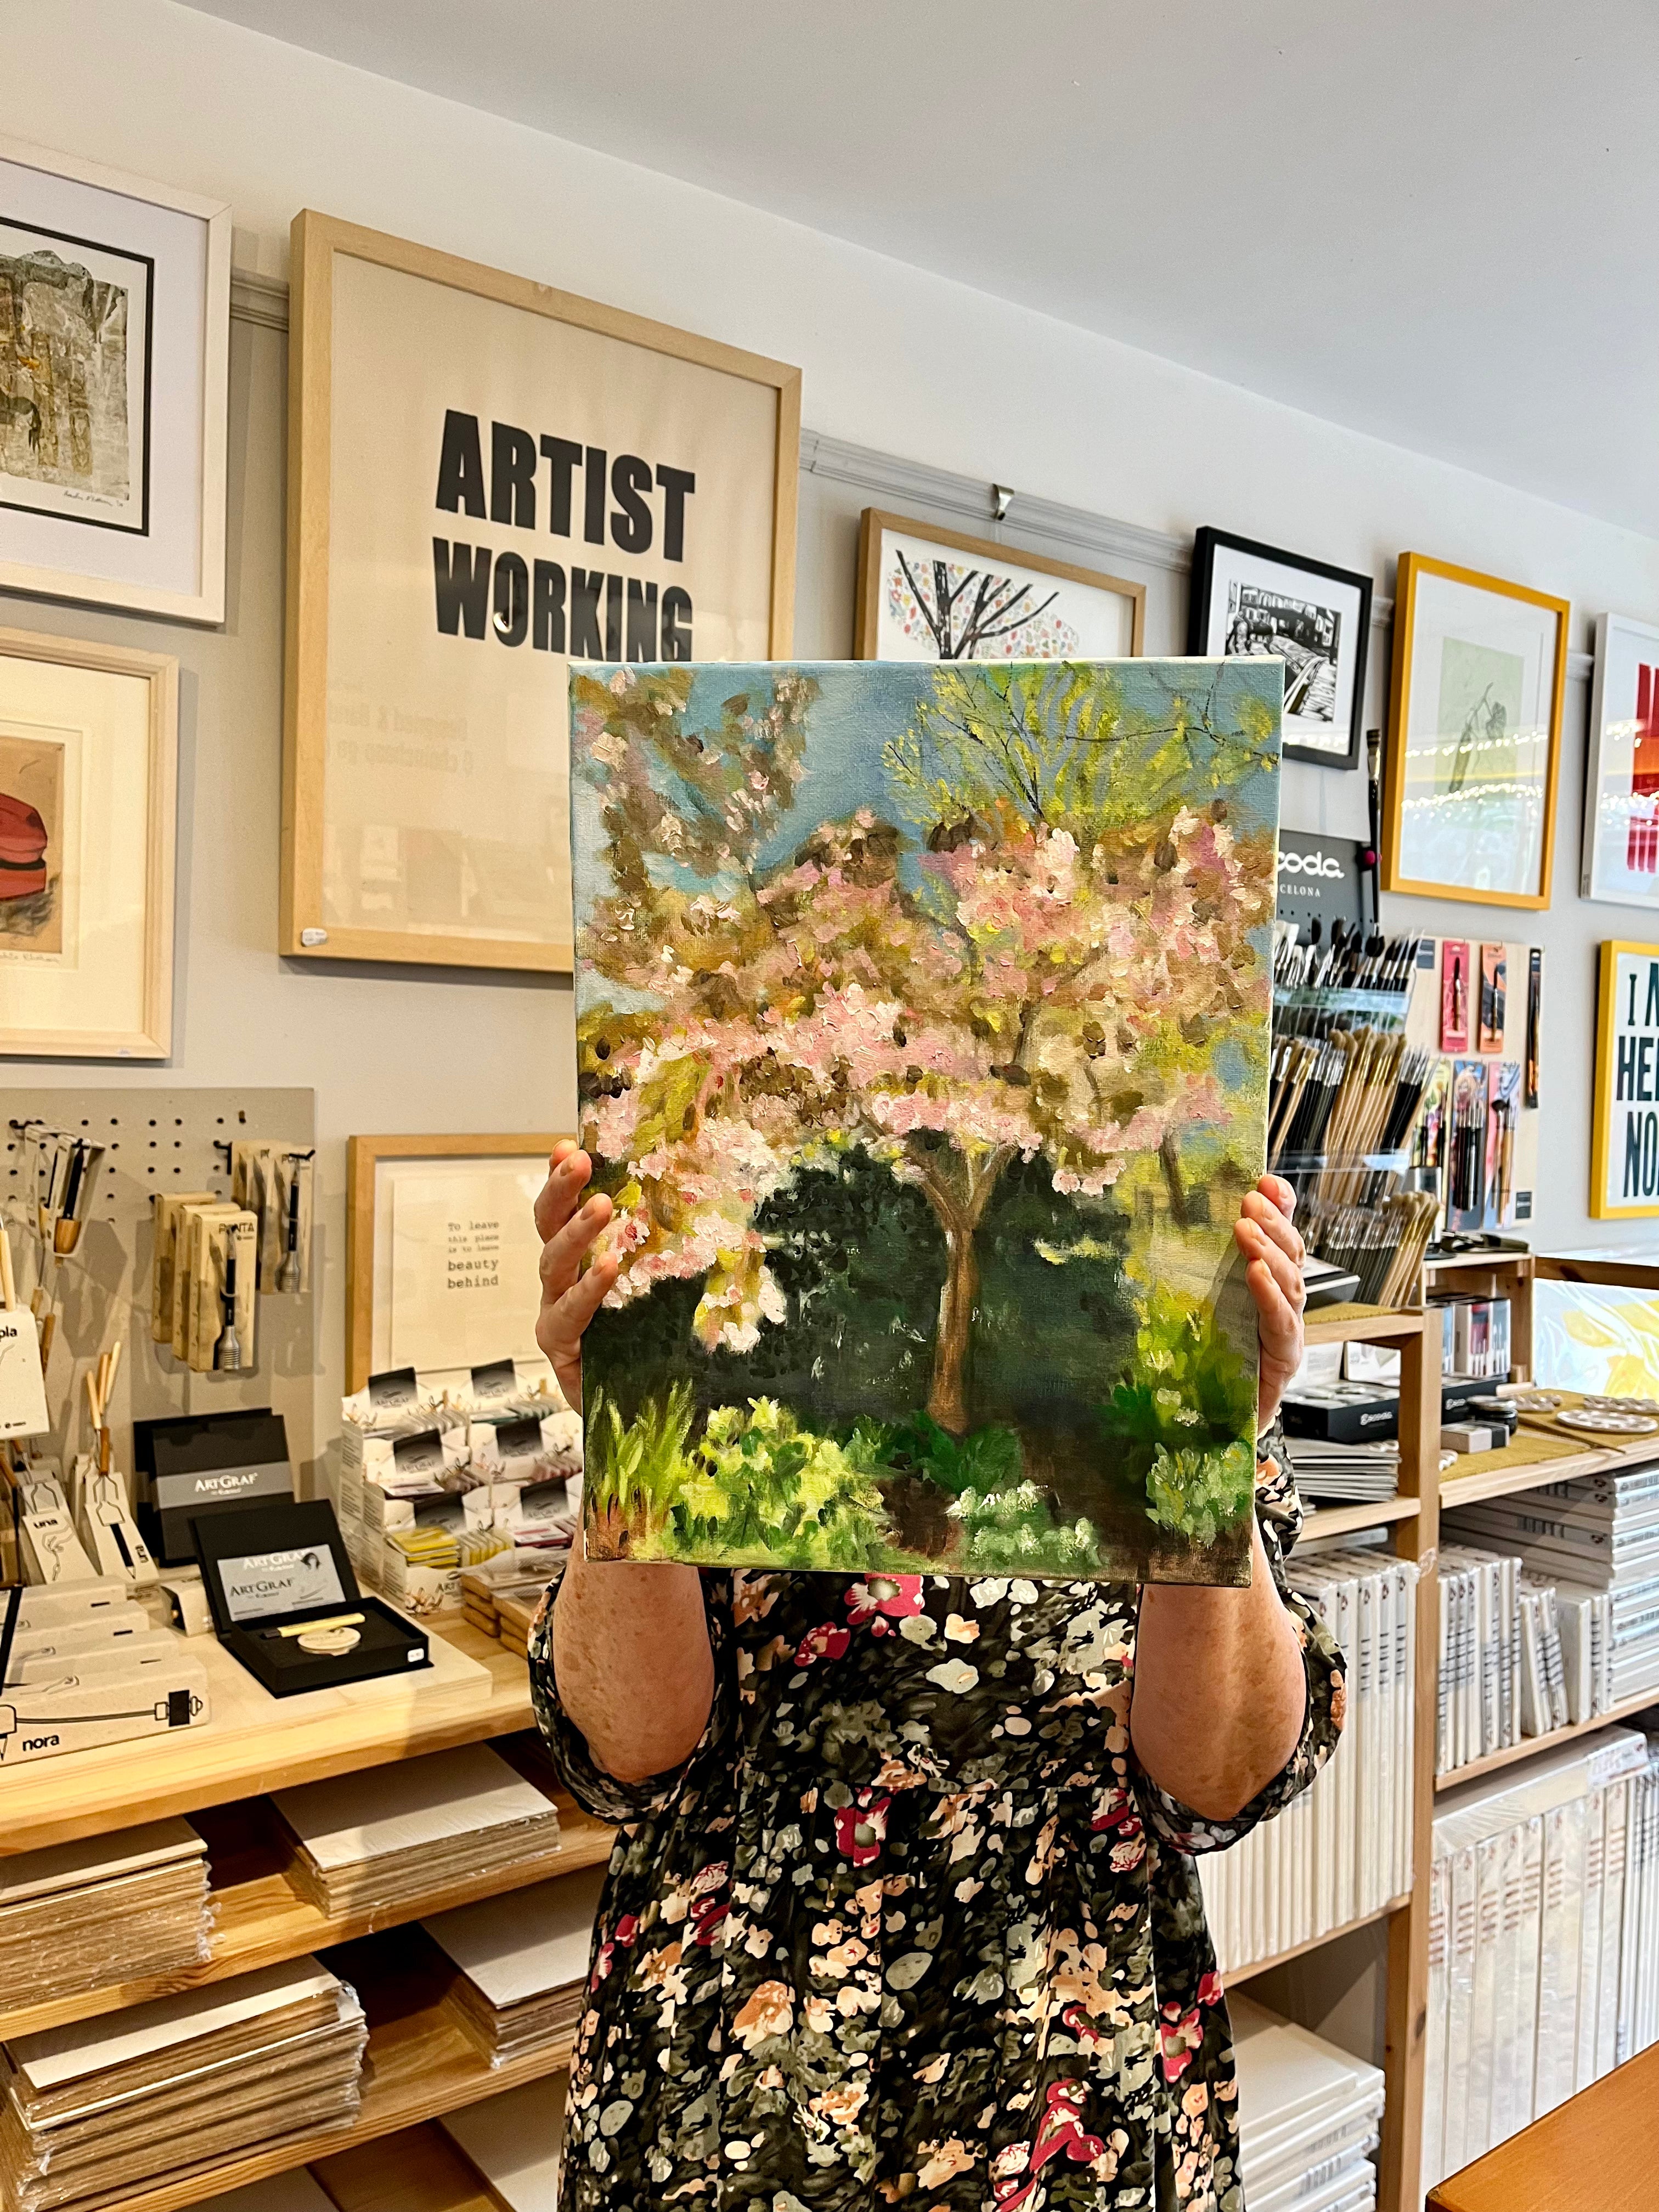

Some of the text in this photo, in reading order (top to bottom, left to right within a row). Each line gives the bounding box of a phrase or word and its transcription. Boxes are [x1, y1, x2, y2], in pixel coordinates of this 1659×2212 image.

[436, 409, 695, 562] ARTIST
[433, 536, 692, 662] WORKING
[1277, 851, 1345, 879] coda
[1279, 883, 1321, 898] CELONA
[1616, 1035, 1659, 1101] HE
[1623, 1111, 1659, 1198] NO
[218, 1222, 255, 1234] PNTA
[469, 1220, 499, 1231] leave
[448, 1259, 499, 1272] beauty
[447, 1274, 499, 1289] behind
[22, 1734, 60, 1751] nora
